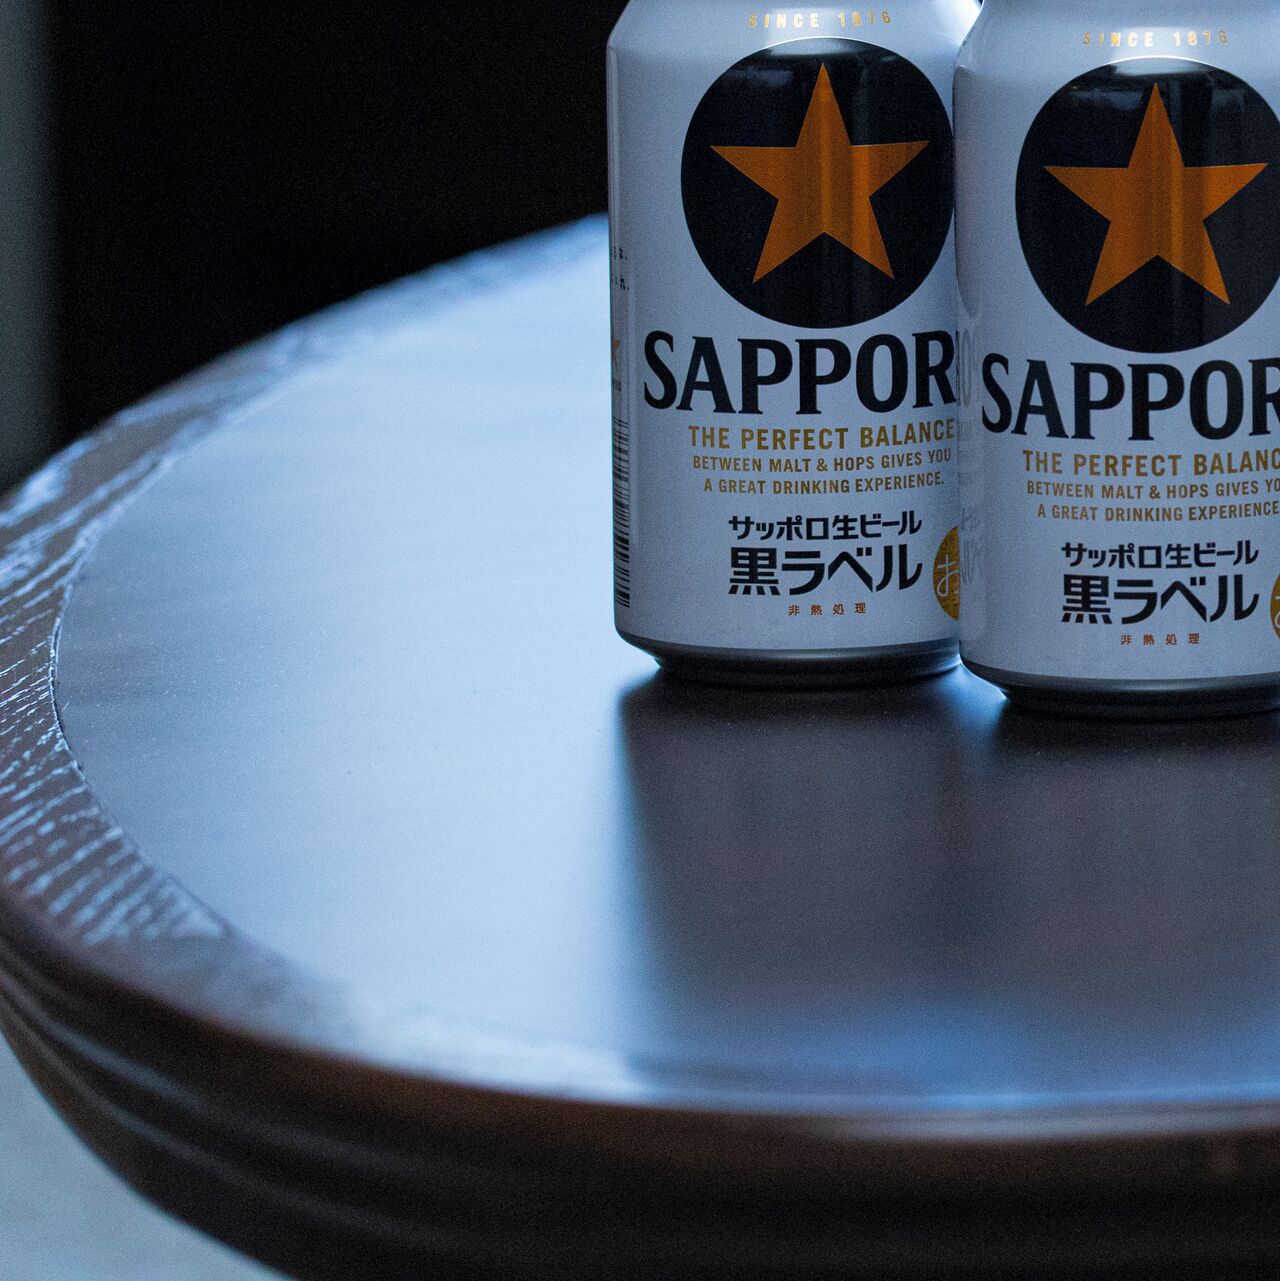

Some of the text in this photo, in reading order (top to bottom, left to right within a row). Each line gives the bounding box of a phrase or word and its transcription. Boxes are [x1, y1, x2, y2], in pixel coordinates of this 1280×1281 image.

[749, 12, 820, 28] SINCE
[1082, 30, 1154, 48] SINCE
[643, 330, 956, 415] SAPPOR
[688, 417, 955, 450] THE PERFECT BALANCE
[693, 447, 952, 473] BETWEEN MALT & HOPS GIVES YOU
[1022, 449, 1062, 474] THE
[1073, 453, 1182, 478] PERFECT
[703, 471, 945, 495] A GREAT DRINKING EXPERIENCE.
[1027, 479, 1094, 498] BETWEEN
[1101, 484, 1142, 499] MALT
[1149, 484, 1161, 499] &
[1166, 483, 1209, 499] HOPS
[1215, 479, 1259, 497] GIVES
[1037, 504, 1046, 518] A
[1052, 504, 1098, 520] GREAT
[1104, 506, 1183, 521] DRINKING
[728, 510, 922, 542] サッポロ生ビール
[1061, 539, 1259, 569] サッポロ生ビール
[728, 544, 923, 596] 黒ラベル
[788, 602, 867, 618] 非熱処理
[1061, 573, 1260, 625] 黒ラベル
[1119, 633, 1201, 647] 非熱処理
